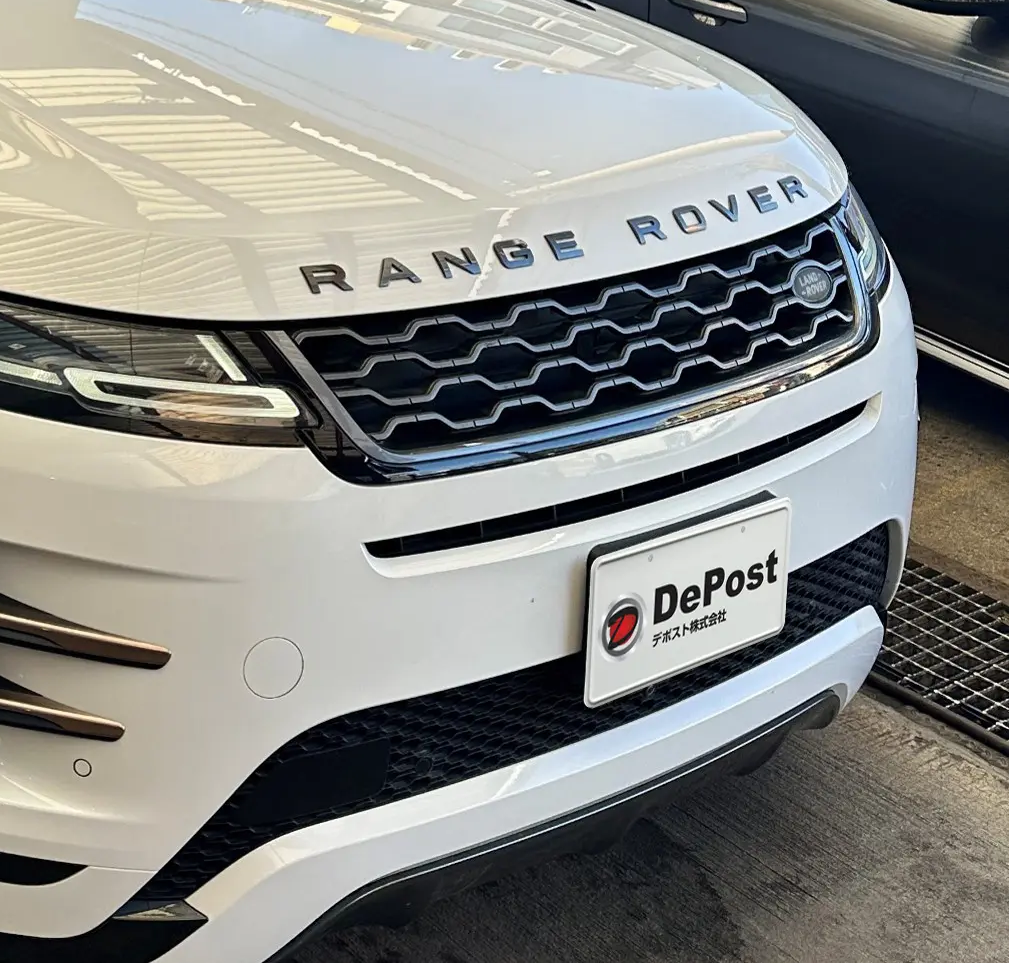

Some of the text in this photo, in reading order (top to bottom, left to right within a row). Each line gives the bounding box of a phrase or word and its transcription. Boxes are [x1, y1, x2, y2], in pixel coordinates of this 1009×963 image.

[299, 175, 809, 295] RANGE ROVER
[798, 272, 819, 287] LAND
[805, 280, 828, 297] ROVER
[653, 548, 779, 626] DePost
[652, 608, 727, 648] デポスト株式会社
